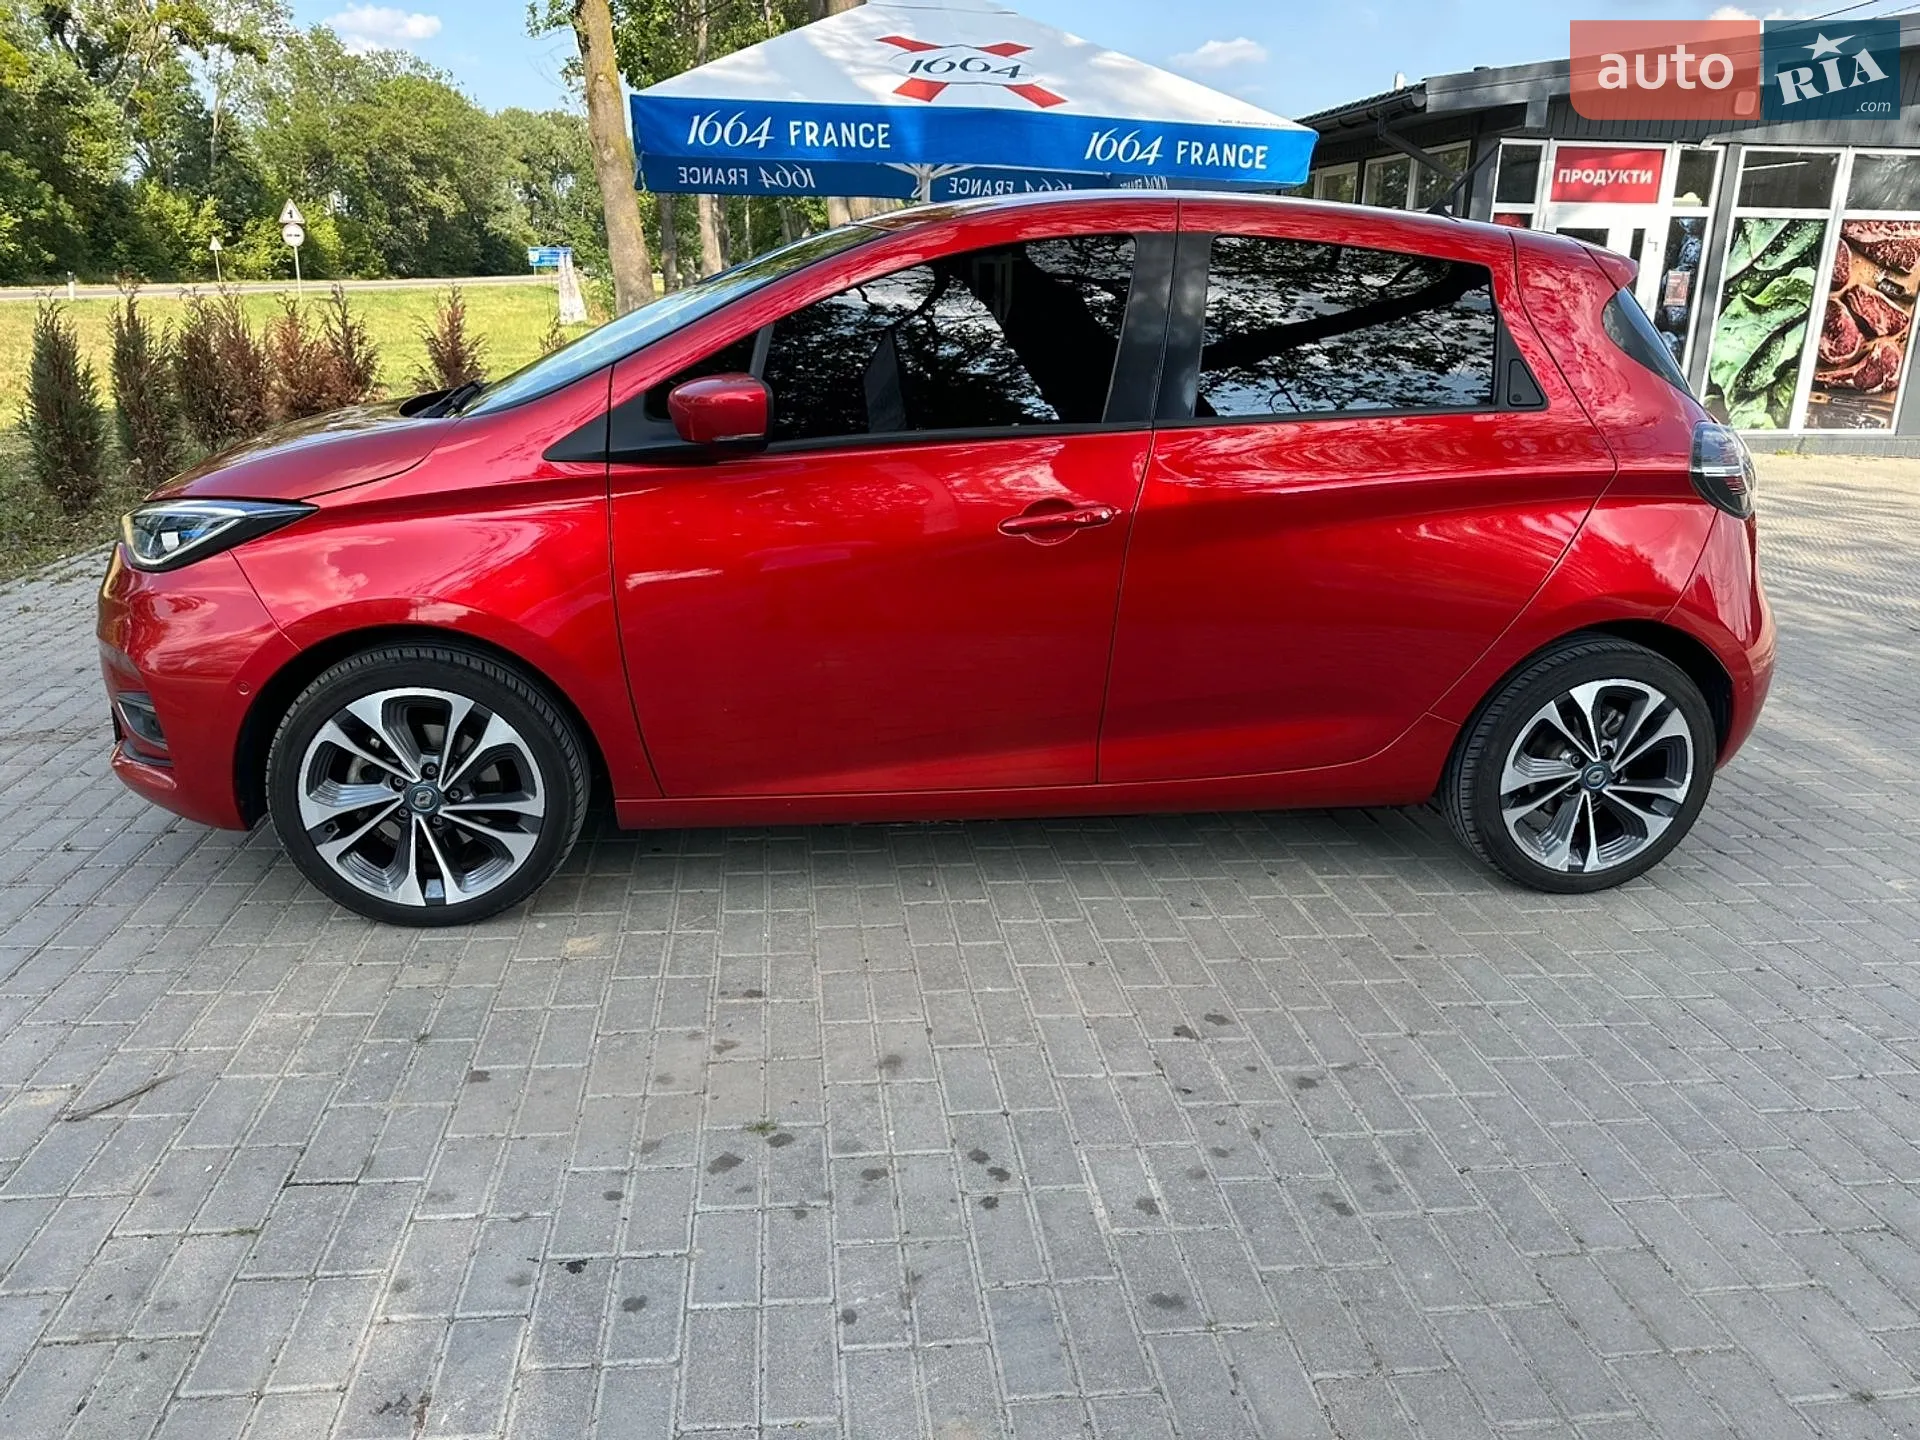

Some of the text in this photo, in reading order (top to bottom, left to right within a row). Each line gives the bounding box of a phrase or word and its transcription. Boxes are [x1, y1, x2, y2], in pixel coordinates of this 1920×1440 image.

[908, 55, 1025, 79] 1664
[687, 110, 891, 149] 1664 FRANCE
[1084, 127, 1269, 170] 1664 FRANCE
[1558, 168, 1653, 186] ПРОДУКТИ
